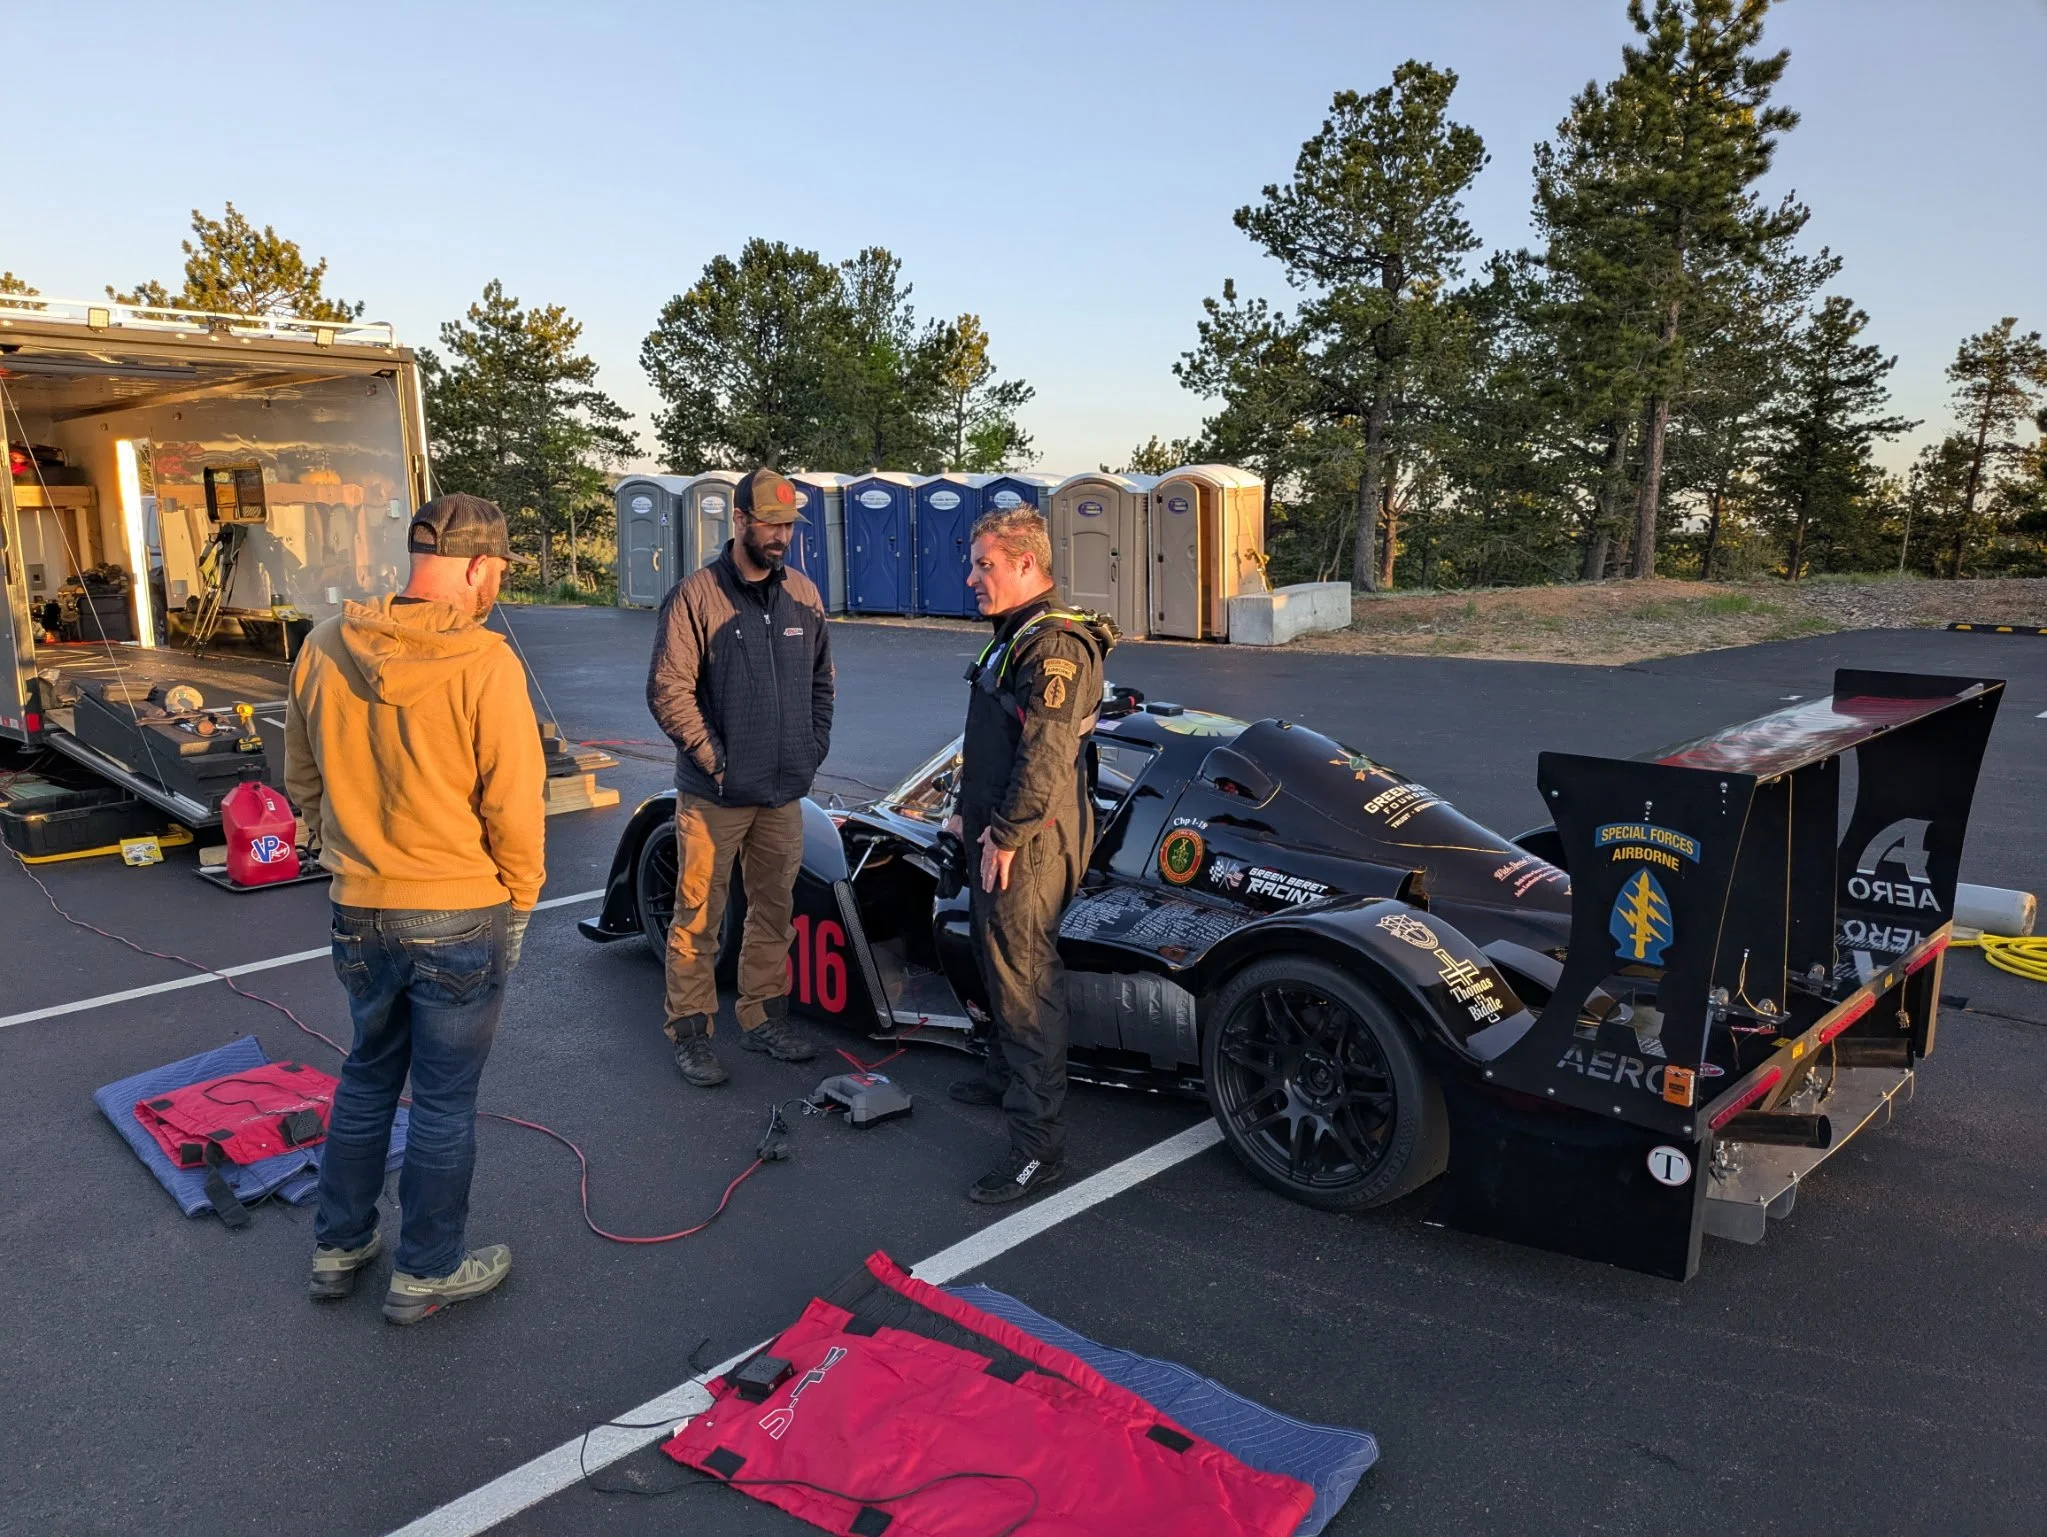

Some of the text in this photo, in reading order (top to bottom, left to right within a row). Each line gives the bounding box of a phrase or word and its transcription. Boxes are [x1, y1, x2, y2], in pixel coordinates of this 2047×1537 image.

[1364, 785, 1410, 814] GREEN
[1383, 791, 1432, 815] FOUNDA
[251, 835, 280, 864] VP
[1601, 825, 1694, 855] SPECIAL FORCES
[1612, 846, 1680, 872] AIRBORNE
[1248, 867, 1329, 893] GREEN BERET
[784, 913, 847, 1013] 16
[1449, 977, 1494, 1003] Thomas
[1467, 998, 1503, 1022] Biddle
[1654, 1151, 1684, 1181] T
